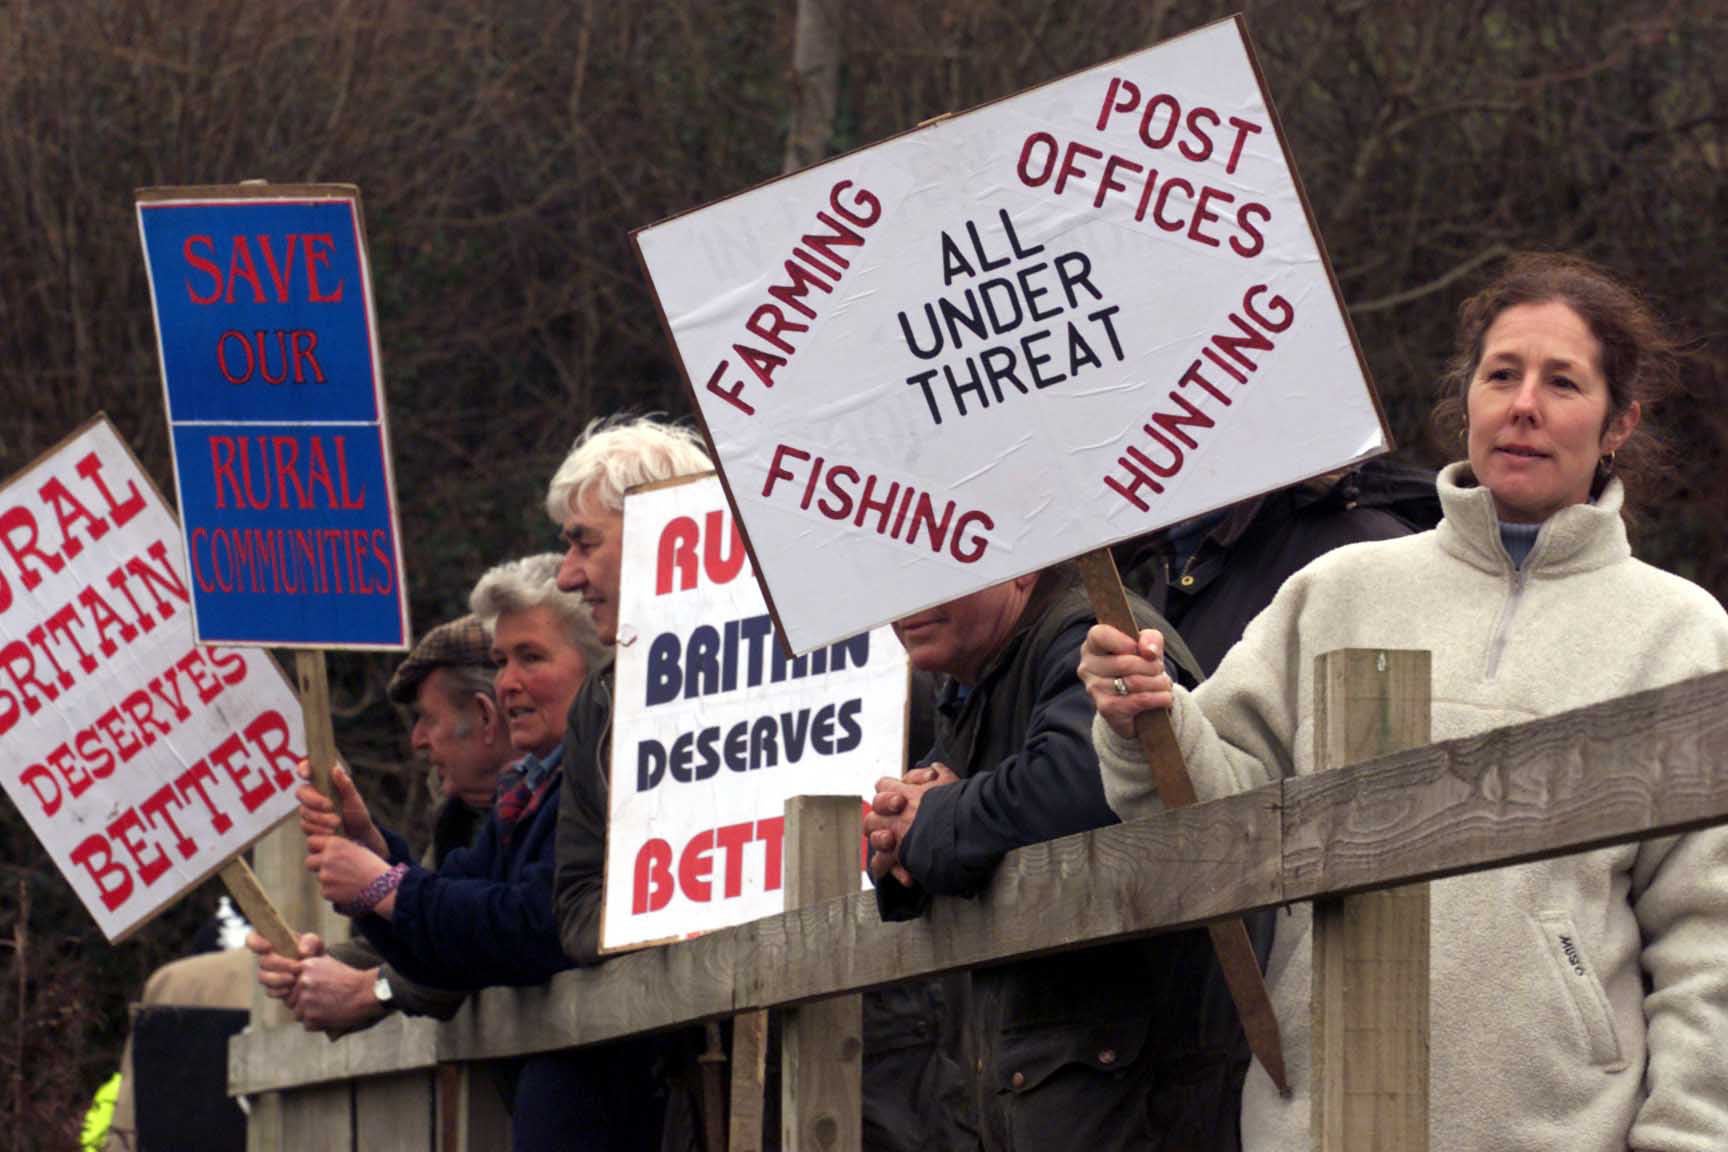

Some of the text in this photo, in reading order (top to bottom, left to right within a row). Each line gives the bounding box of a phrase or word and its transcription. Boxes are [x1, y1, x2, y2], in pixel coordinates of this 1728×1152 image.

[1096, 77, 1261, 174] POST
[941, 208, 1044, 286] ALL
[1018, 132, 1271, 257] OFFICES
[183, 234, 343, 304] SAVE
[707, 179, 882, 415] FARMING
[897, 252, 1102, 360] UNDER
[216, 329, 327, 384] OUR
[906, 305, 1125, 425] THREAT
[1103, 284, 1295, 512] HUNTING
[208, 436, 366, 510] RURAL
[761, 444, 994, 563] FISHING
[0, 451, 148, 615] RAL
[190, 527, 393, 595] COMMUNITIES
[18, 646, 248, 818] DESERVES
[637, 698, 862, 792] DESERVES
[69, 709, 308, 912] BETTER
[631, 800, 872, 916] BETT
